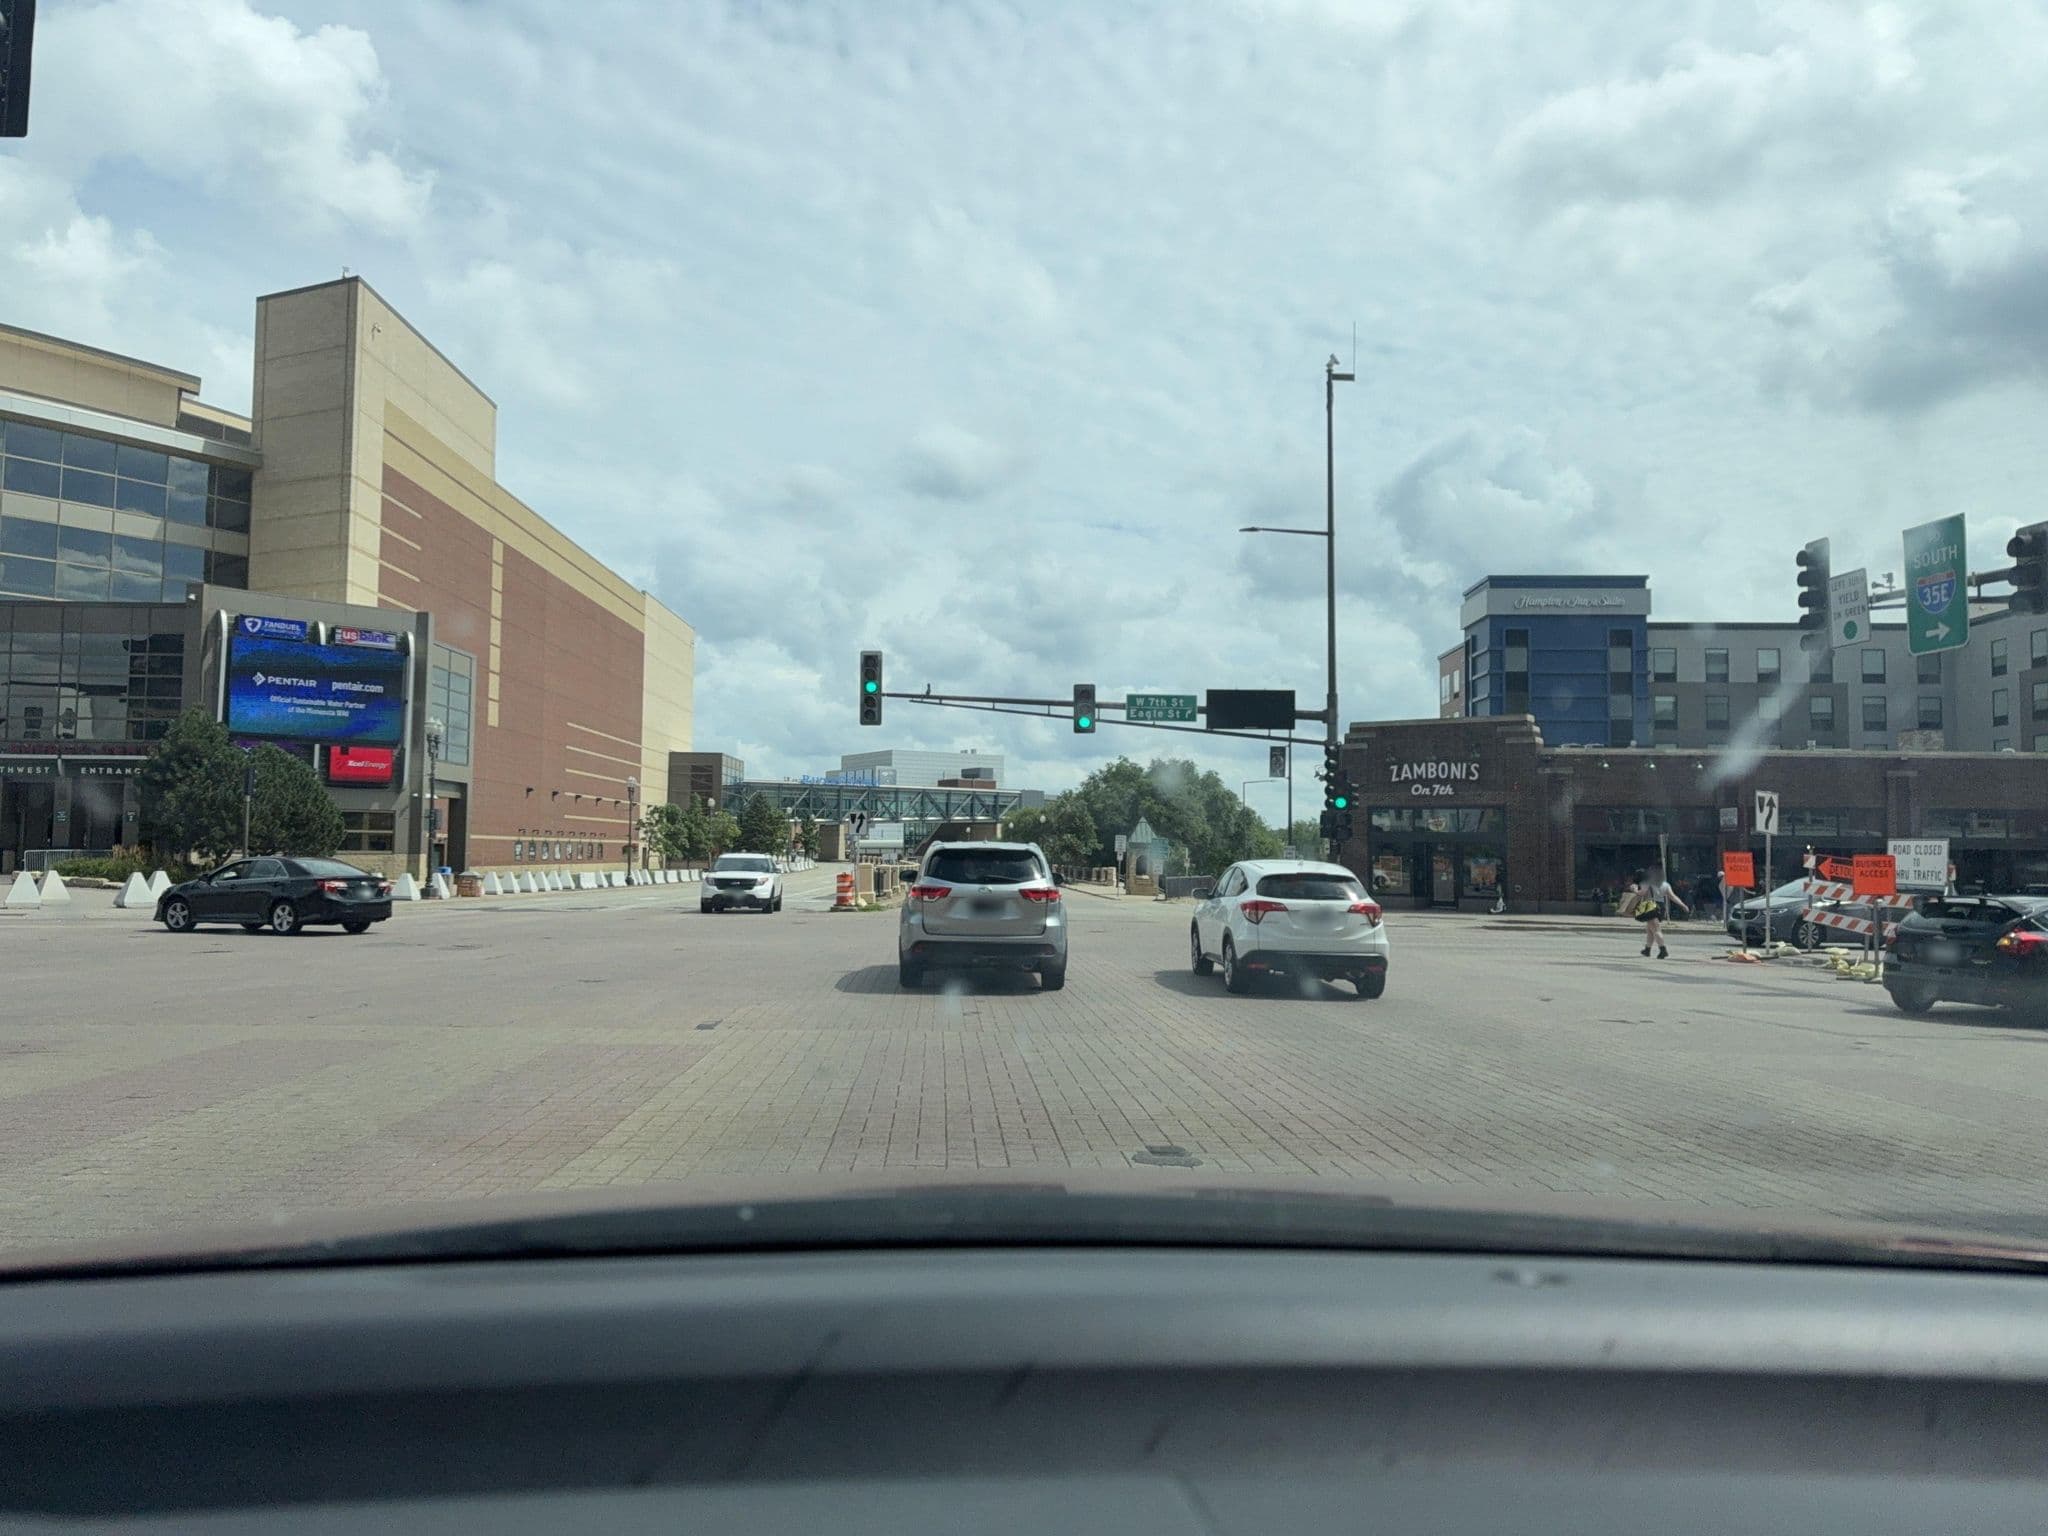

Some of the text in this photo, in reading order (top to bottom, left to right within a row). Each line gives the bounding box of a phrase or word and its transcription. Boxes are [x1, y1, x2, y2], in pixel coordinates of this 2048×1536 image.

[1913, 544, 1958, 569] SOUTH
[1840, 590, 1859, 604] YIELD
[1922, 582, 1950, 606] 35E
[1514, 594, 1562, 609] Hampton
[264, 621, 301, 632] FANDUEL
[268, 676, 384, 693] PENTAIR pentair.com
[1136, 698, 1184, 707] W 7th St
[1130, 709, 1180, 720] Eagle St
[81, 767, 142, 775] ENTRANC
[1411, 783, 1455, 796] On 7th
[1893, 845, 1943, 856] ROAD CLOSED
[1913, 858, 1920, 866] TO
[1831, 864, 1853, 877] DETOU
[1856, 860, 1892, 878] BUSINESS ACCESS
[1895, 870, 1943, 881] HRU TRAFFIC
